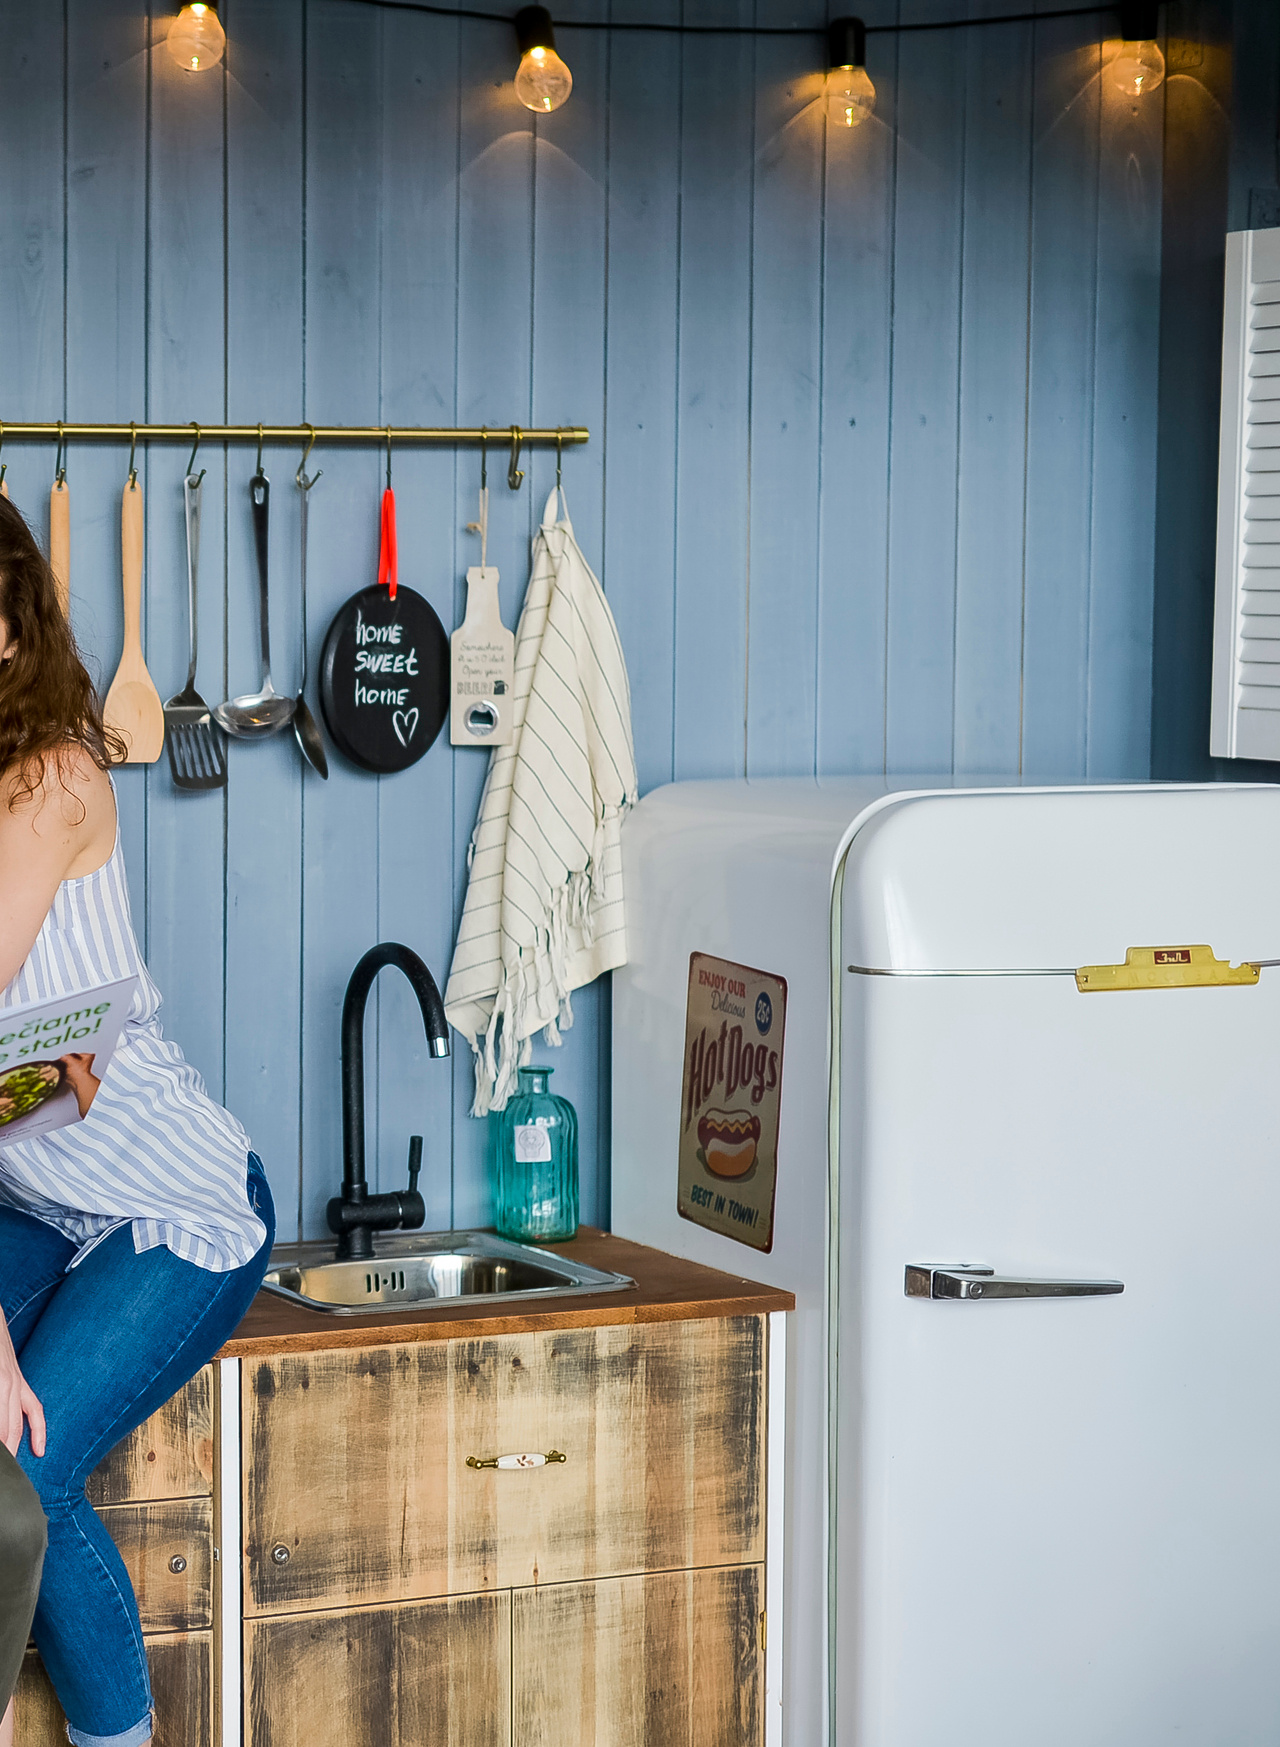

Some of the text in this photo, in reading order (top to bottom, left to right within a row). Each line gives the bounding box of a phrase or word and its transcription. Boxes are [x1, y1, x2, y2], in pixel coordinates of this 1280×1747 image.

[698, 969, 746, 999] ENJOY OUR
[711, 989, 746, 1019] Delicious
[18, 1017, 103, 1058] stalo!
[690, 1184, 760, 1229] BEST IN TOWN!
